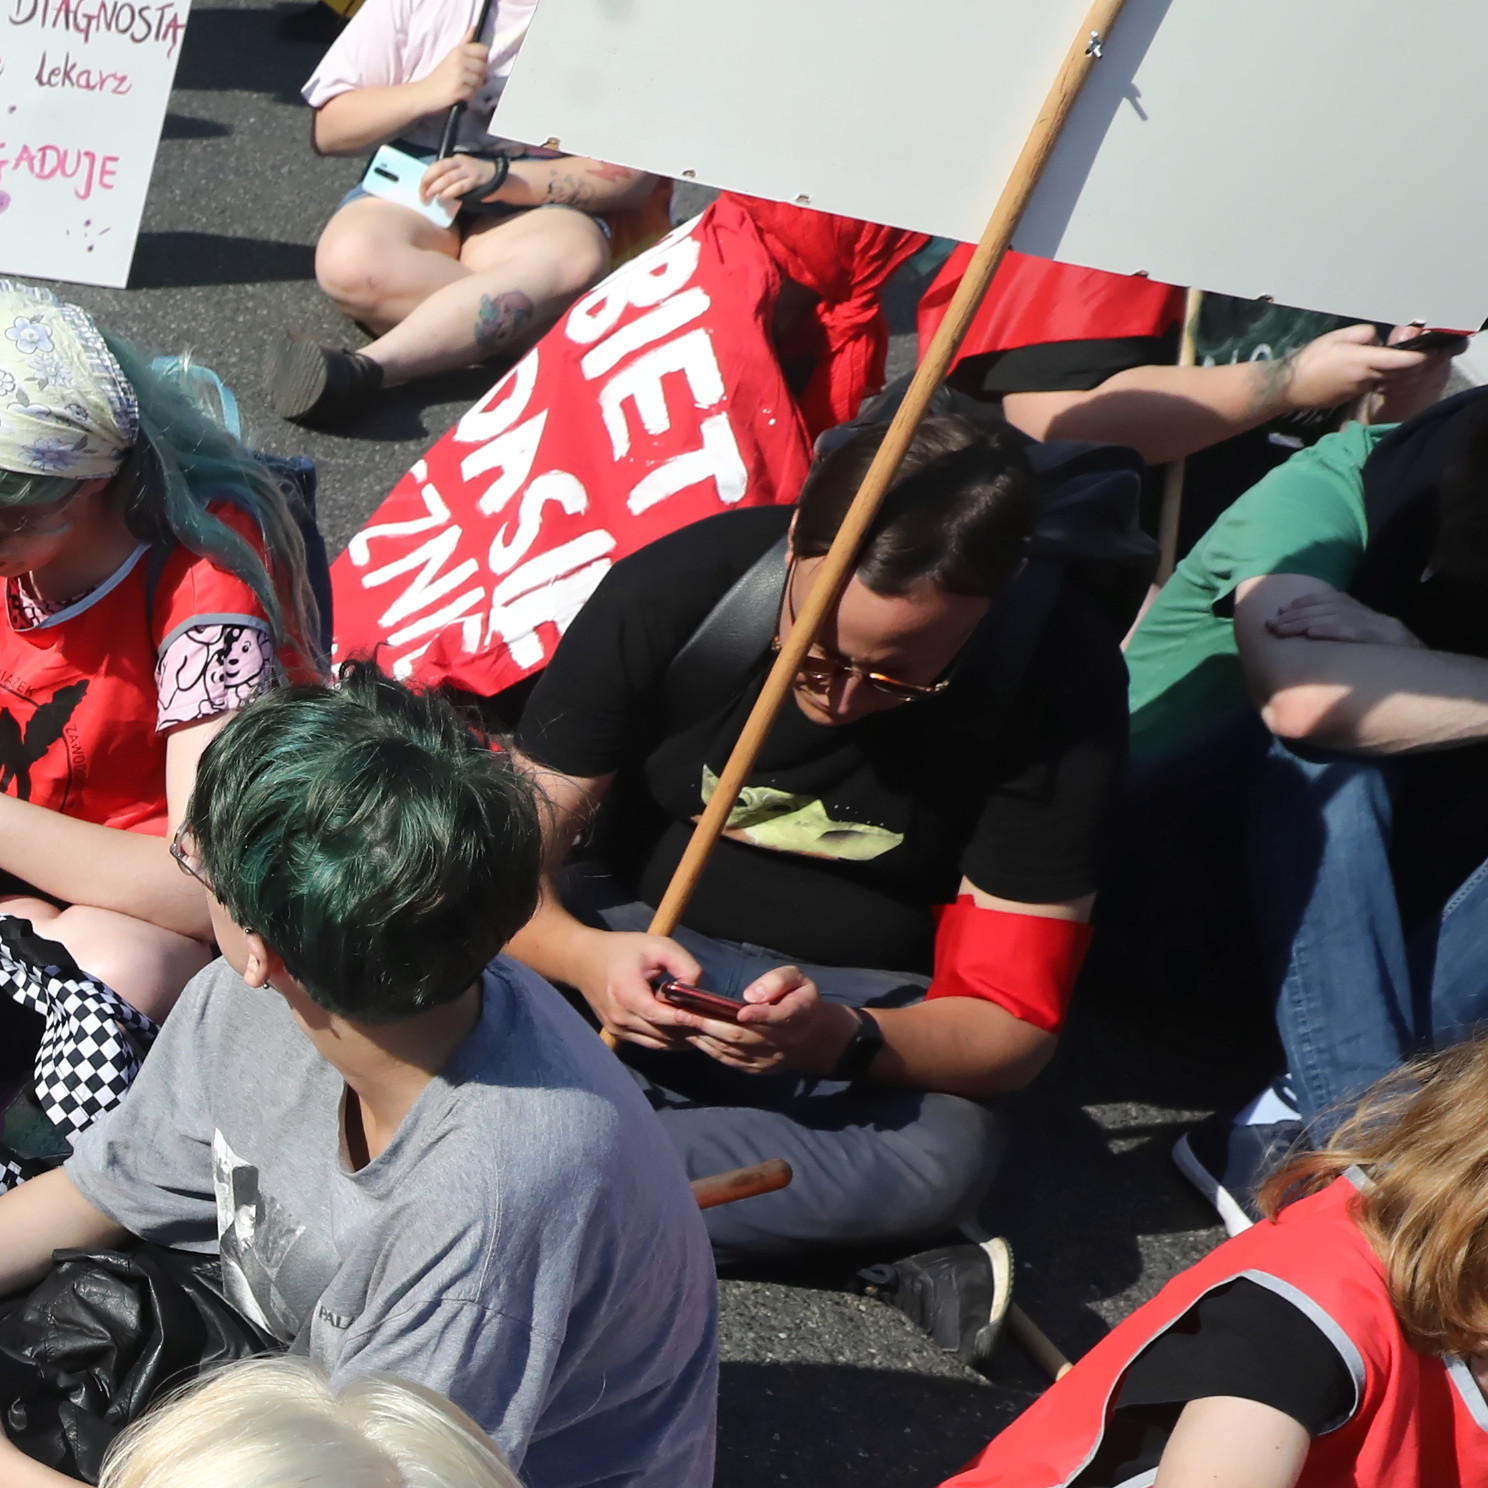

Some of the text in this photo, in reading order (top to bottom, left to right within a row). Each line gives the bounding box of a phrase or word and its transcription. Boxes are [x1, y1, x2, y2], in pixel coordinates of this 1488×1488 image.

[9, 0, 187, 58] DIAGNOSTĄ
[35, 51, 133, 96] lekarz
[565, 212, 749, 516] BIET
